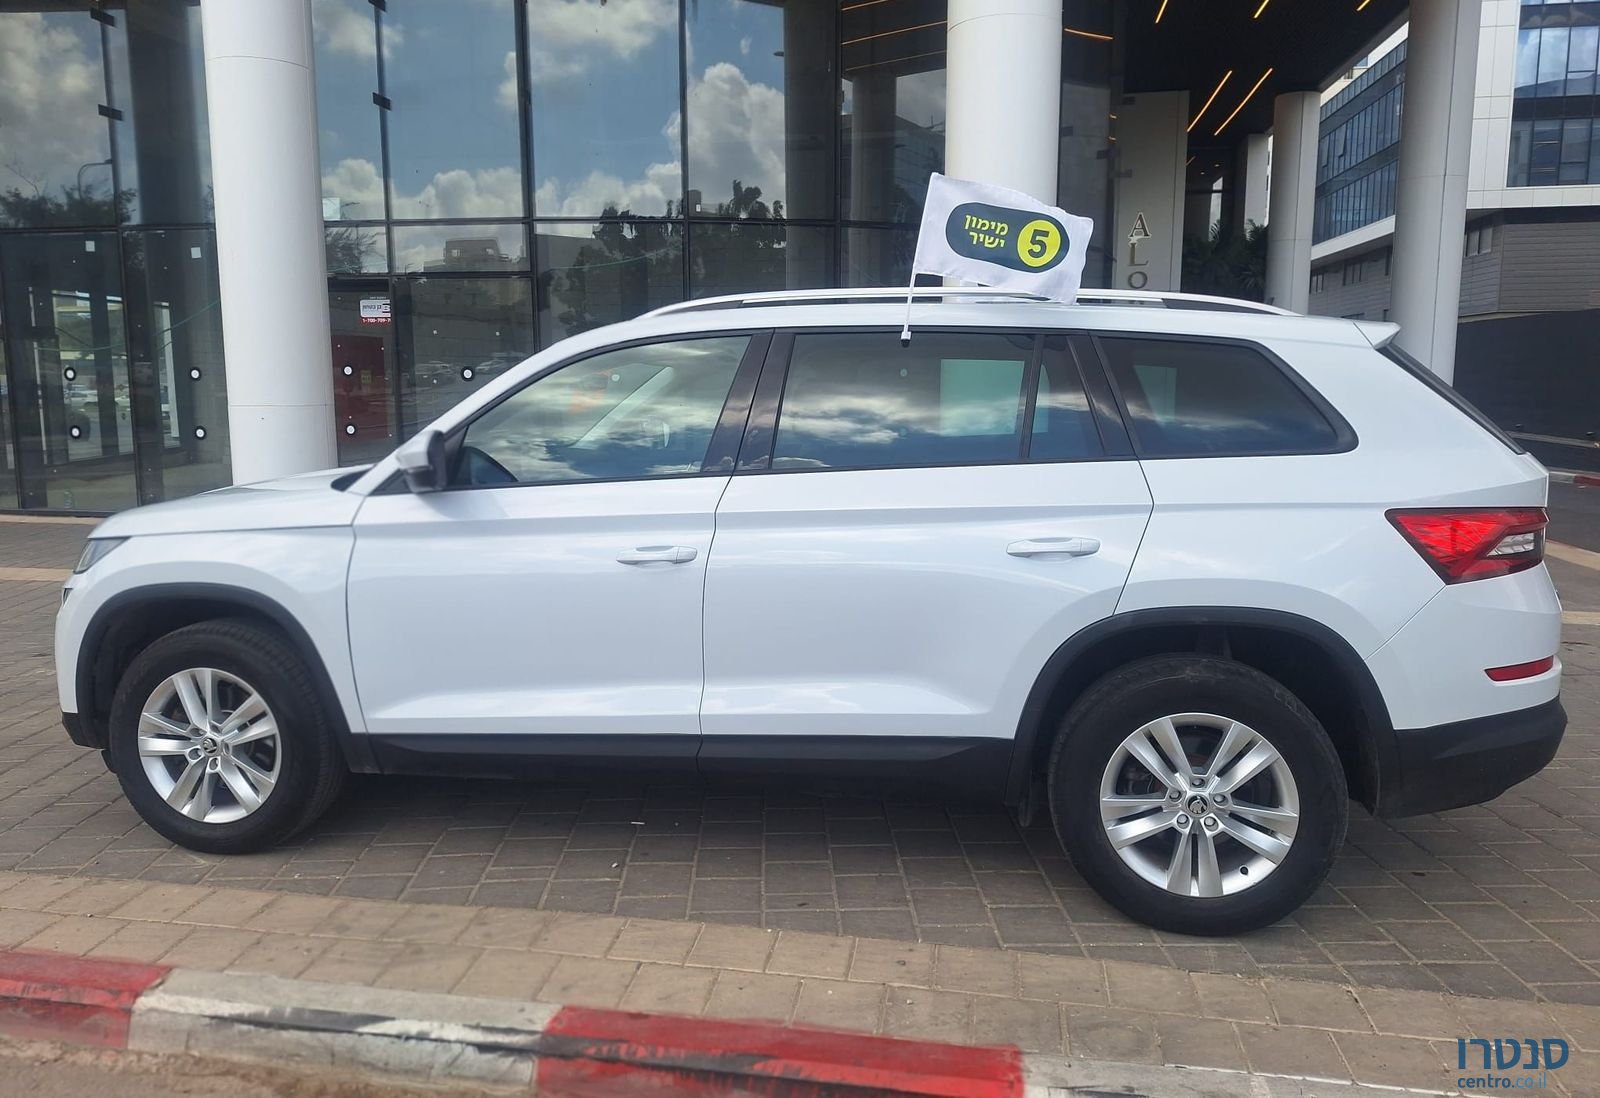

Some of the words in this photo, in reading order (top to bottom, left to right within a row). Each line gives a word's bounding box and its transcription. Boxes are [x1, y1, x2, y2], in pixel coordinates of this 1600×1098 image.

[964, 214, 1009, 236] מימון
[969, 231, 1006, 248] ישיר
[1027, 229, 1050, 259] 5
[1127, 211, 1152, 304] ALO
